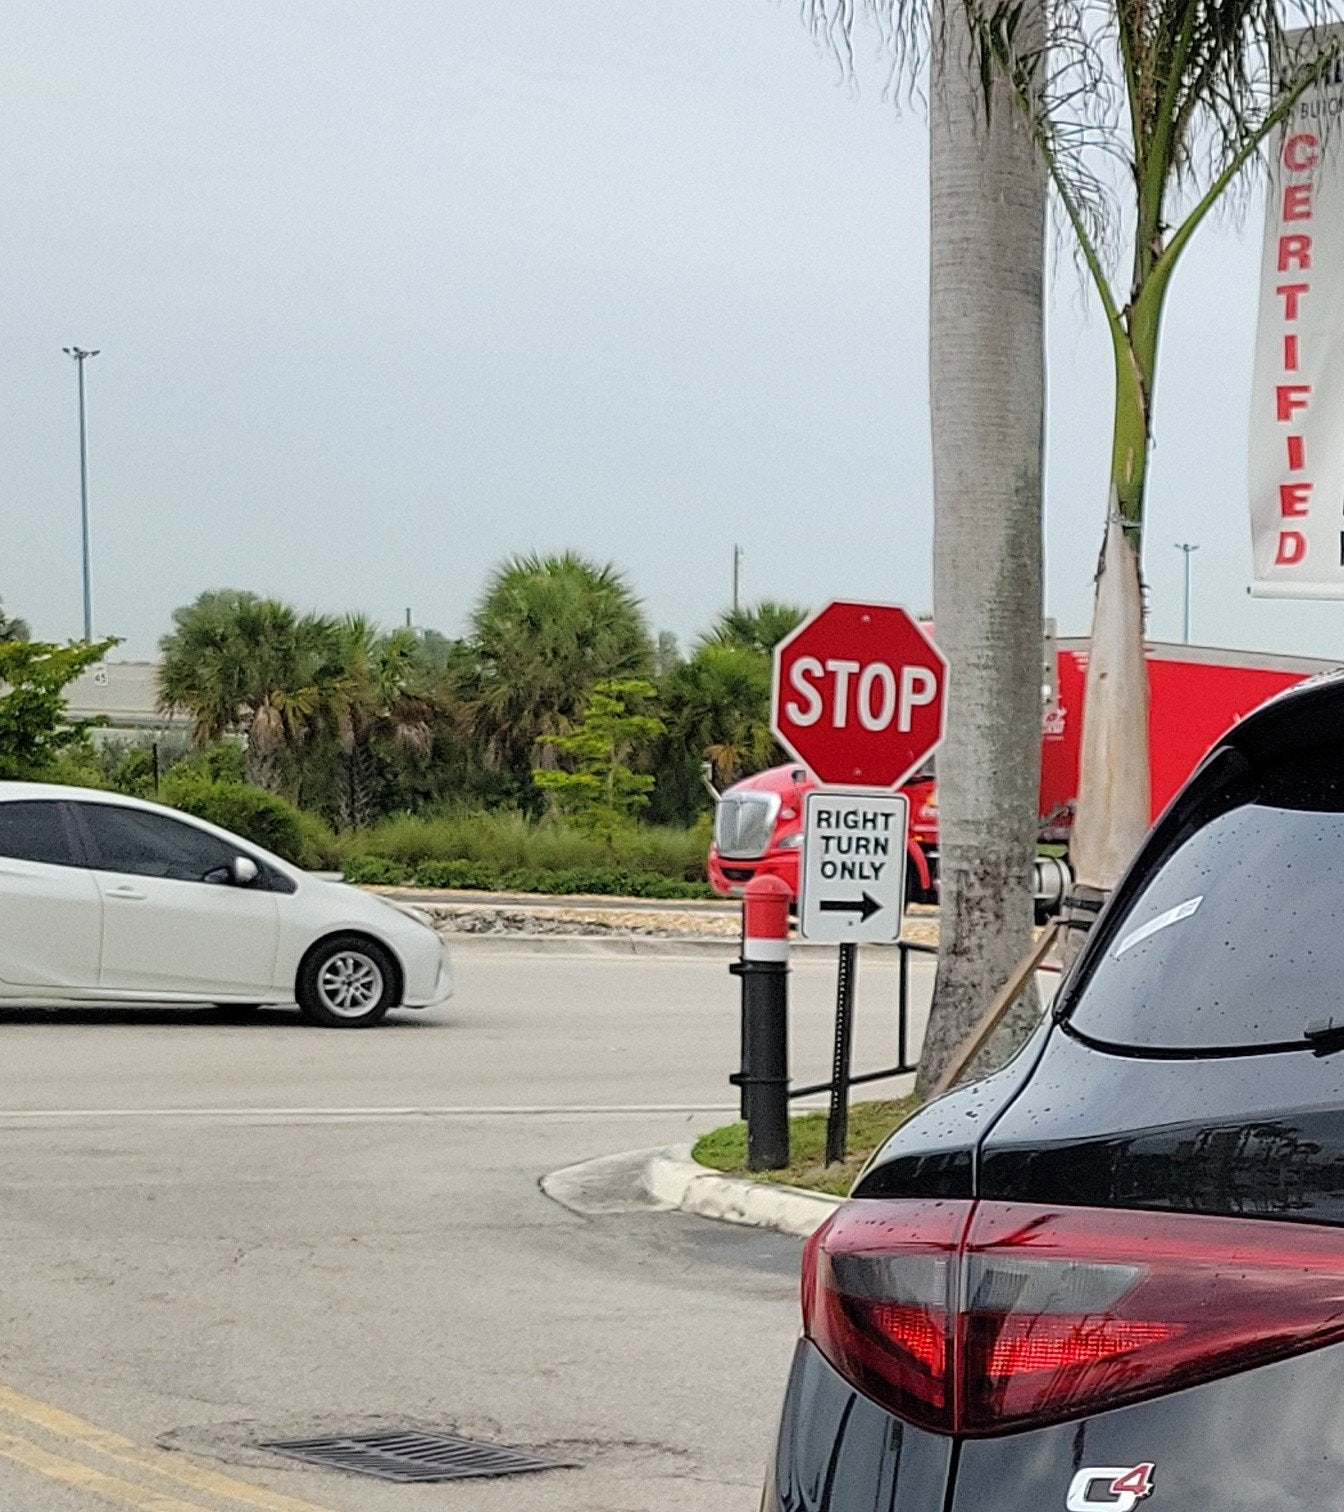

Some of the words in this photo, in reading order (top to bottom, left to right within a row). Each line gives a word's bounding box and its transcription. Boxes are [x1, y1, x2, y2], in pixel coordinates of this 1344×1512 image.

[1275, 133, 1318, 567] CERTIFIED
[785, 655, 938, 733] STOP
[816, 809, 896, 830] RIGHT
[822, 835, 889, 856] TURN
[820, 861, 886, 881] ONLY
